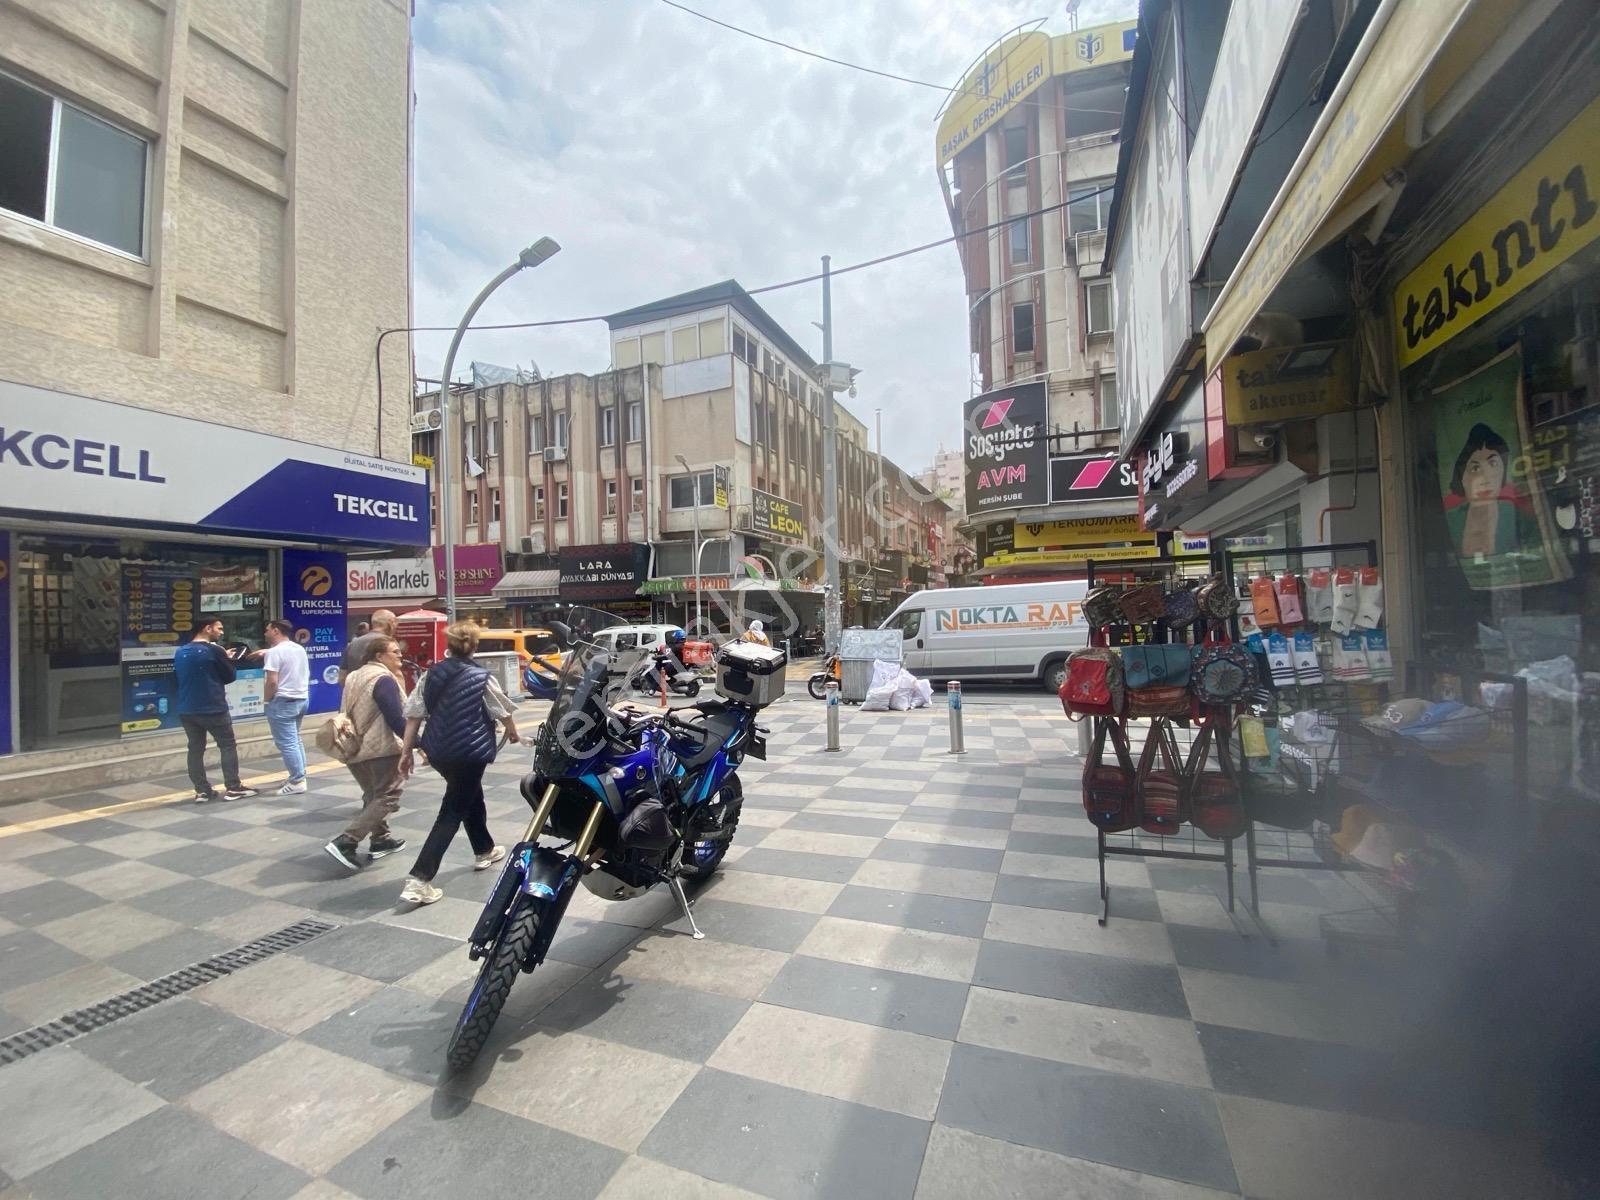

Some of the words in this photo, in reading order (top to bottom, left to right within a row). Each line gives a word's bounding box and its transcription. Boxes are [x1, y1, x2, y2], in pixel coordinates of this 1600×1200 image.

[1402, 164, 1598, 350] takıntı
[969, 424, 1035, 461] Sosyete
[977, 463, 1026, 490] AVM
[978, 495, 1002, 505] MERSİN
[1002, 493, 1023, 502] ŞUBE
[333, 493, 418, 522] TEKCELL
[769, 501, 789, 515] CAFE
[769, 513, 803, 535] LEON
[1051, 514, 1140, 529] TEKNOMARK
[579, 560, 612, 570] LARA
[560, 573, 599, 583] AYAKKABI
[600, 570, 635, 582] DÜNYASI
[289, 600, 342, 608] TURKCELL
[935, 605, 1018, 632] NOKTA
[315, 627, 334, 636] PAY
[315, 634, 338, 643] CELL
